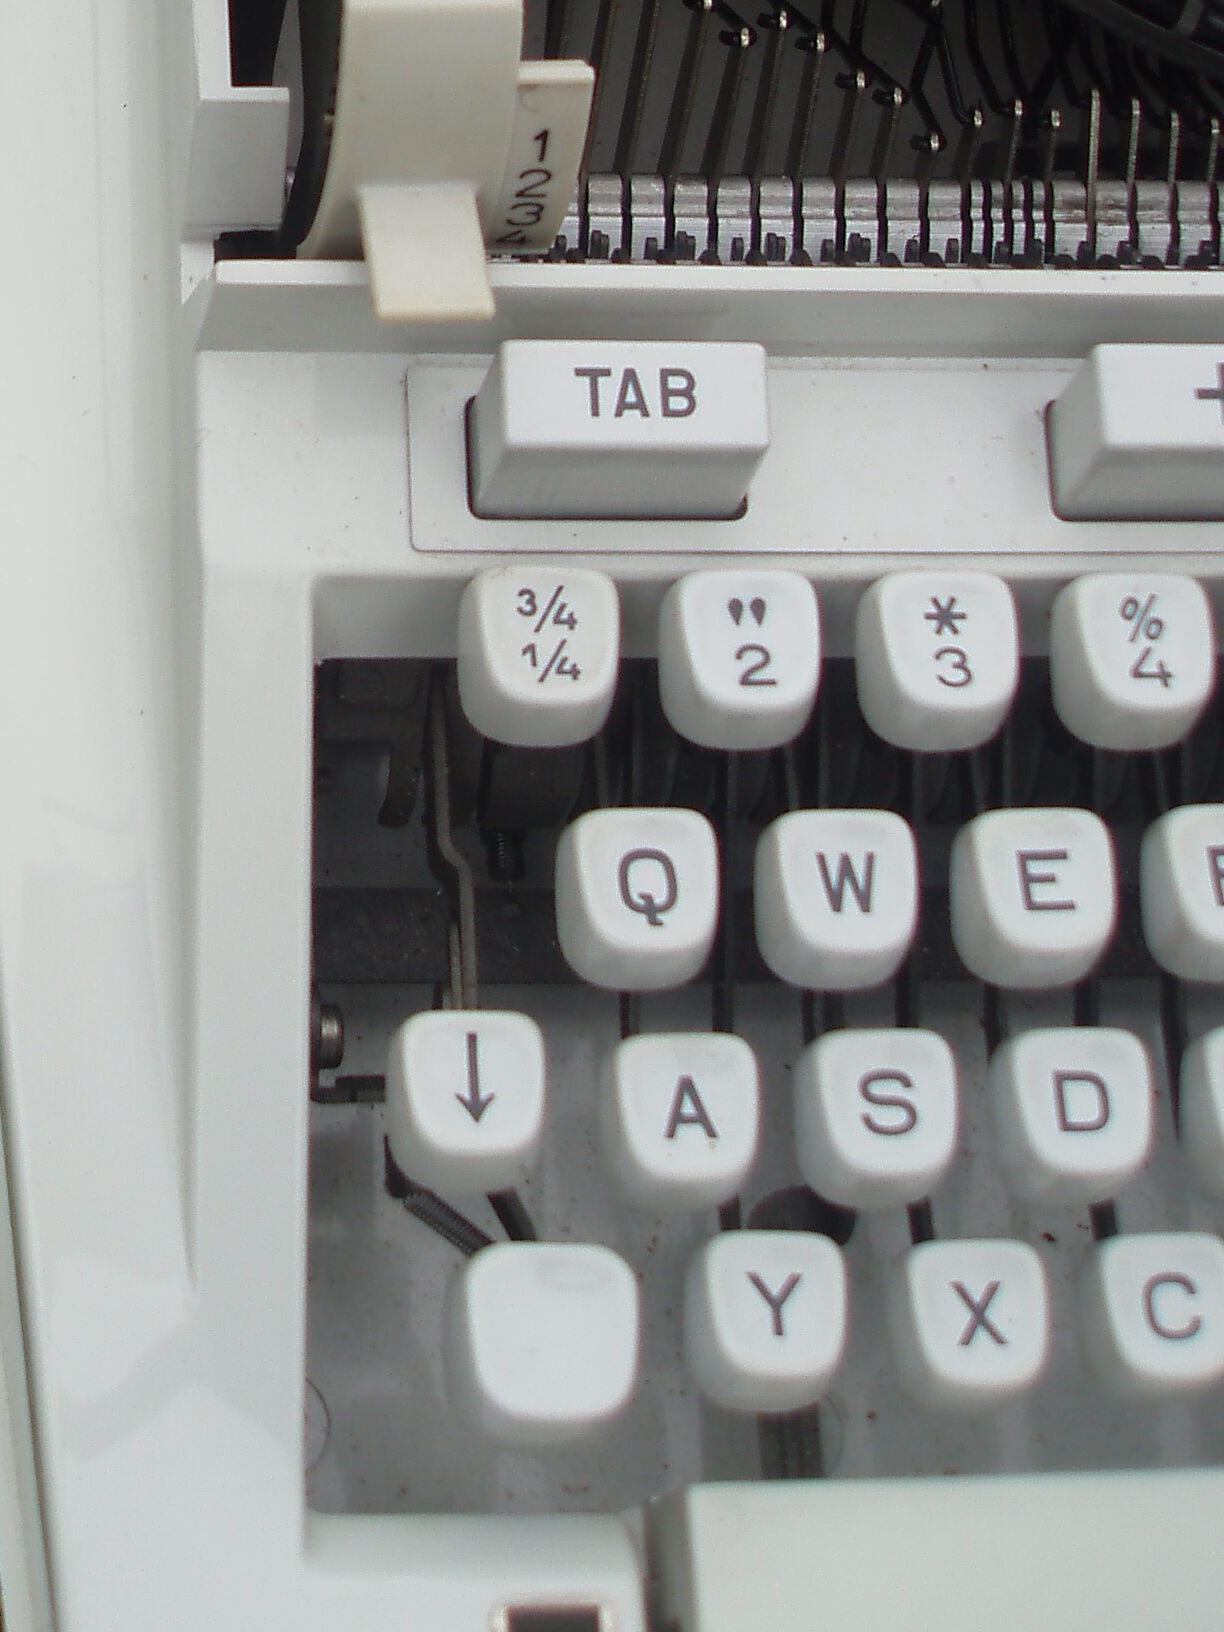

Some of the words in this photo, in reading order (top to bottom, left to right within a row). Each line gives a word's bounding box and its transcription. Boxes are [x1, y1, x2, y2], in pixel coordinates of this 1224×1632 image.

[533, 128, 550, 163] 1
[506, 202, 545, 226] 3
[515, 168, 552, 198] 2
[573, 366, 698, 419] TAB
[735, 643, 778, 687] 2
[934, 646, 974, 689] 3
[1130, 646, 1173, 689] 4
[617, 848, 679, 927] Q
[815, 851, 875, 914] W
[1016, 849, 1076, 912] E
[665, 1074, 718, 1140] A
[858, 1069, 918, 1136] S
[1052, 1070, 1112, 1133] D
[746, 1271, 802, 1337] Y
[951, 1280, 1009, 1347] X
[1142, 1271, 1203, 1342] C
